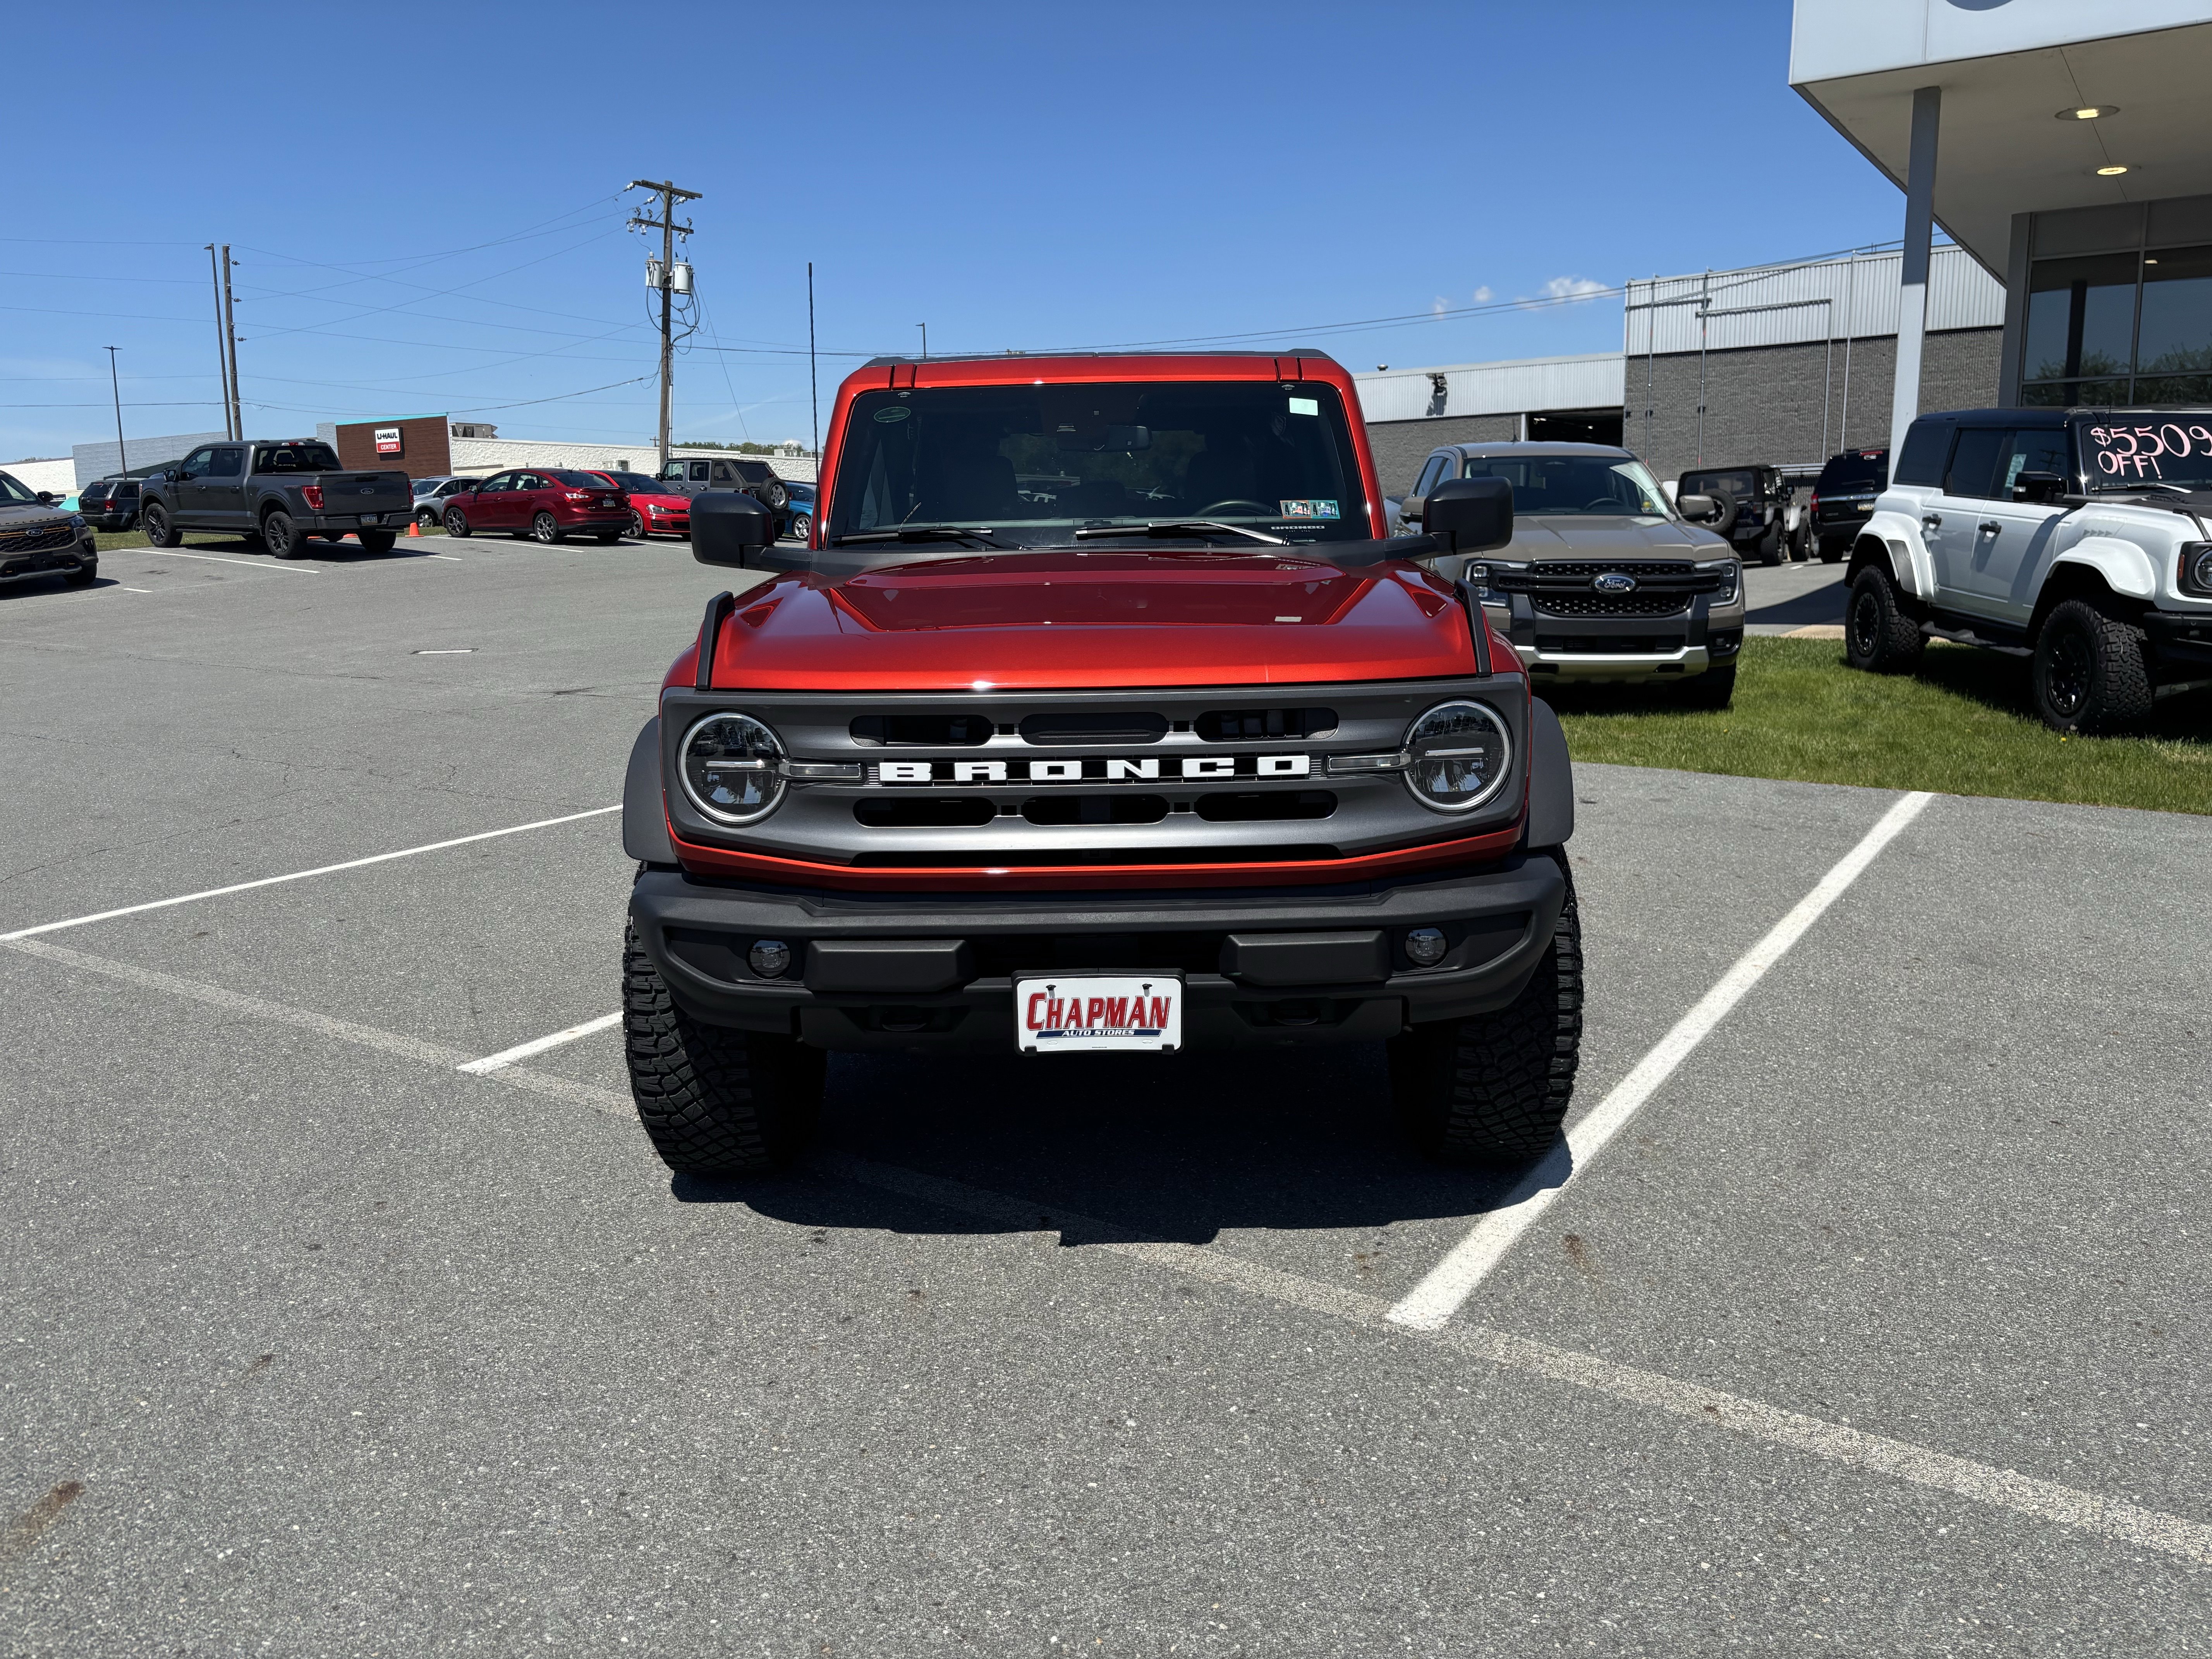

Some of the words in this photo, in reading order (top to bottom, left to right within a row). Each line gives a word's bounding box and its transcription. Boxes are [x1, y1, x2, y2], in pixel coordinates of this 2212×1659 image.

[2090, 424, 2212, 457] $5509
[2098, 450, 2162, 479] OFF!
[1285, 504, 1290, 515] 4
[1313, 504, 1318, 515] 4
[879, 756, 1310, 782] BRONCO
[1026, 992, 1171, 1030] CHAPMAN
